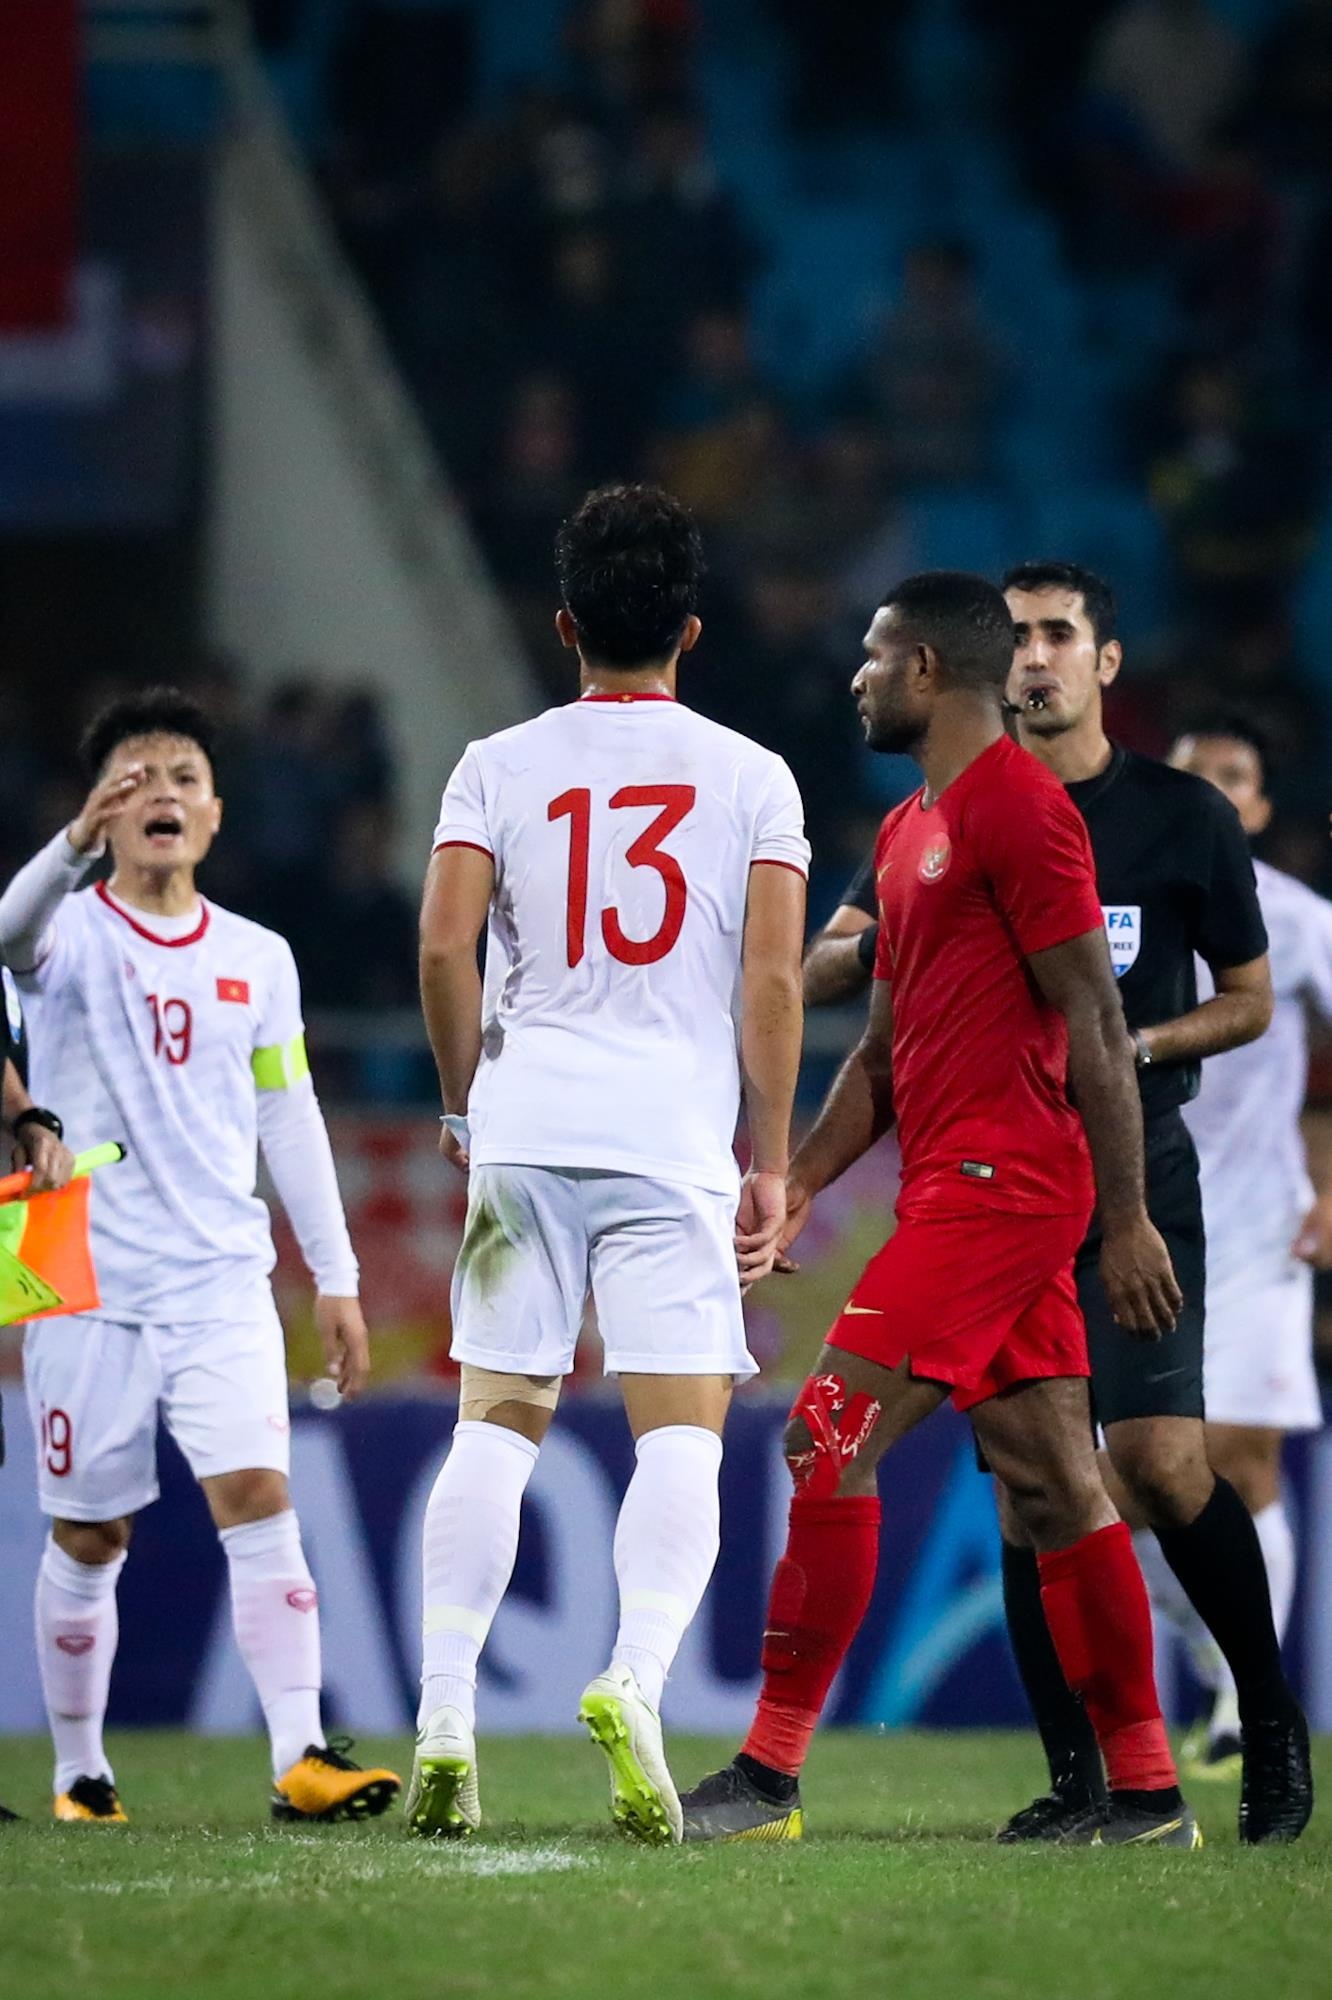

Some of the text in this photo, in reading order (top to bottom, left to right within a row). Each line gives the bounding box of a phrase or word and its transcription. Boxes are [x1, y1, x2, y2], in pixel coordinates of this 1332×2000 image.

[547, 784, 696, 969] 13
[145, 993, 192, 1066] 19
[40, 1400, 72, 1478] 19
